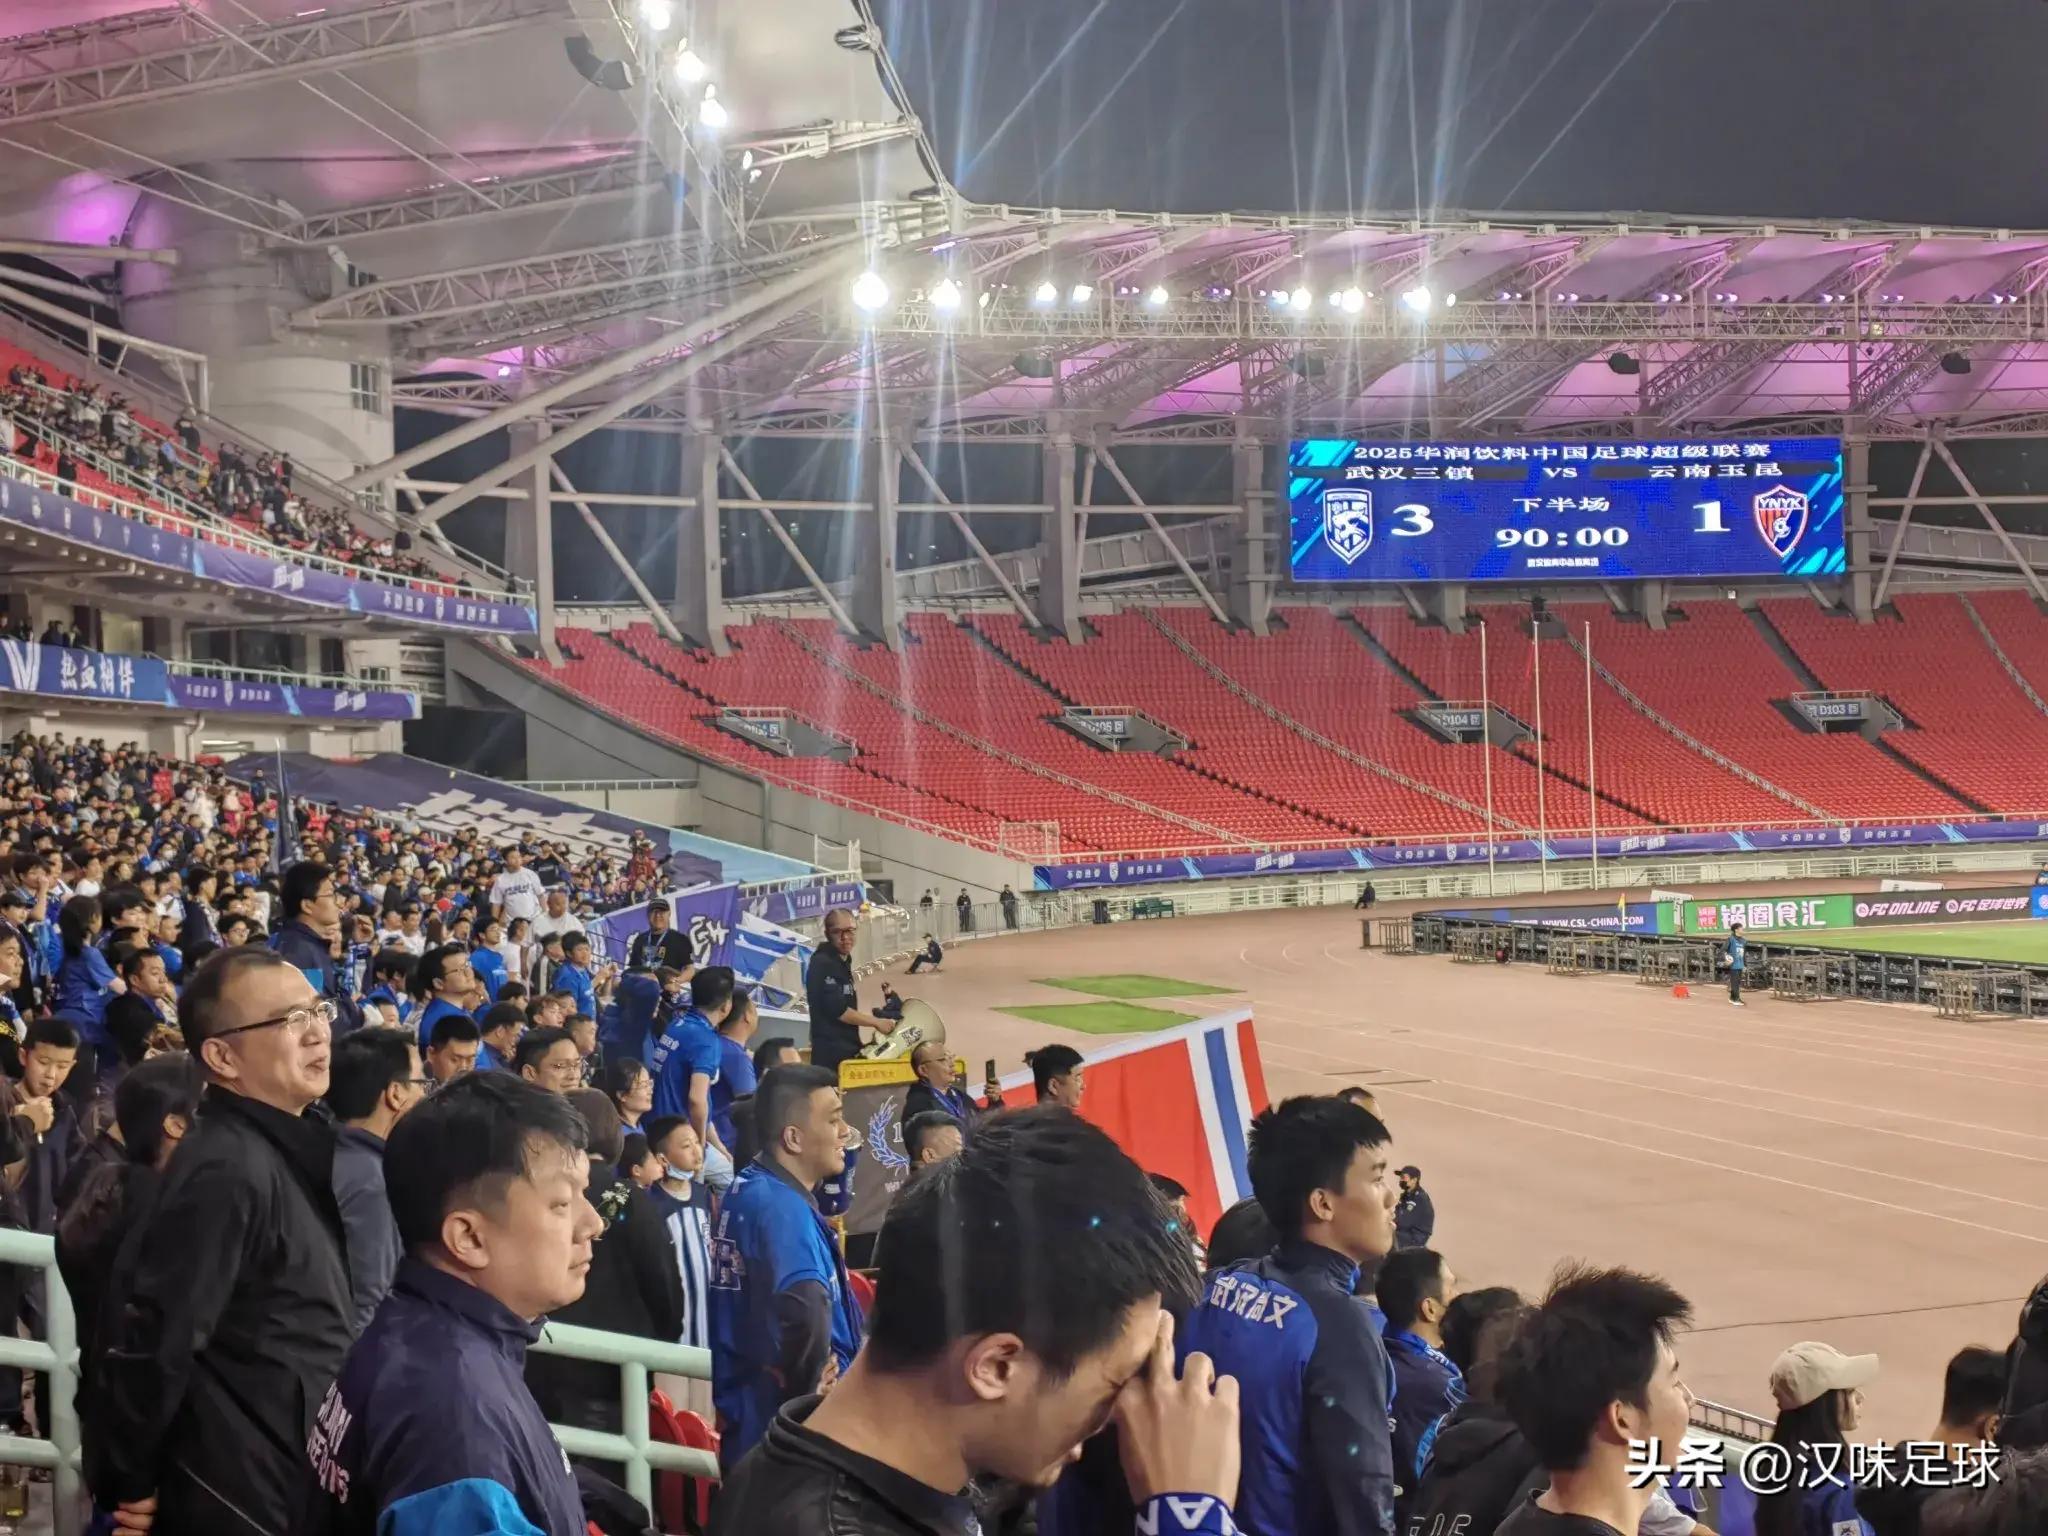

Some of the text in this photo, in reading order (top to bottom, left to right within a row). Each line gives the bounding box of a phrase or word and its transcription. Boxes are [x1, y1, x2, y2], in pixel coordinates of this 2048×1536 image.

[1354, 444, 1771, 460] 2025华润饮料中国足球超级联赛
[1345, 465, 1475, 480] 武汉三镇
[1543, 467, 1578, 478] VS
[1649, 463, 1783, 478] 云南玉昆
[1512, 496, 1610, 513] 下半场
[1759, 497, 1802, 509] YNYK
[1391, 503, 1434, 537] 3
[1692, 500, 1731, 532] 1
[1496, 527, 1629, 547] 90:00
[1819, 704, 1846, 715] D103
[1721, 900, 1827, 930] 锅圈食汇
[1889, 901, 1941, 915] ONLINE
